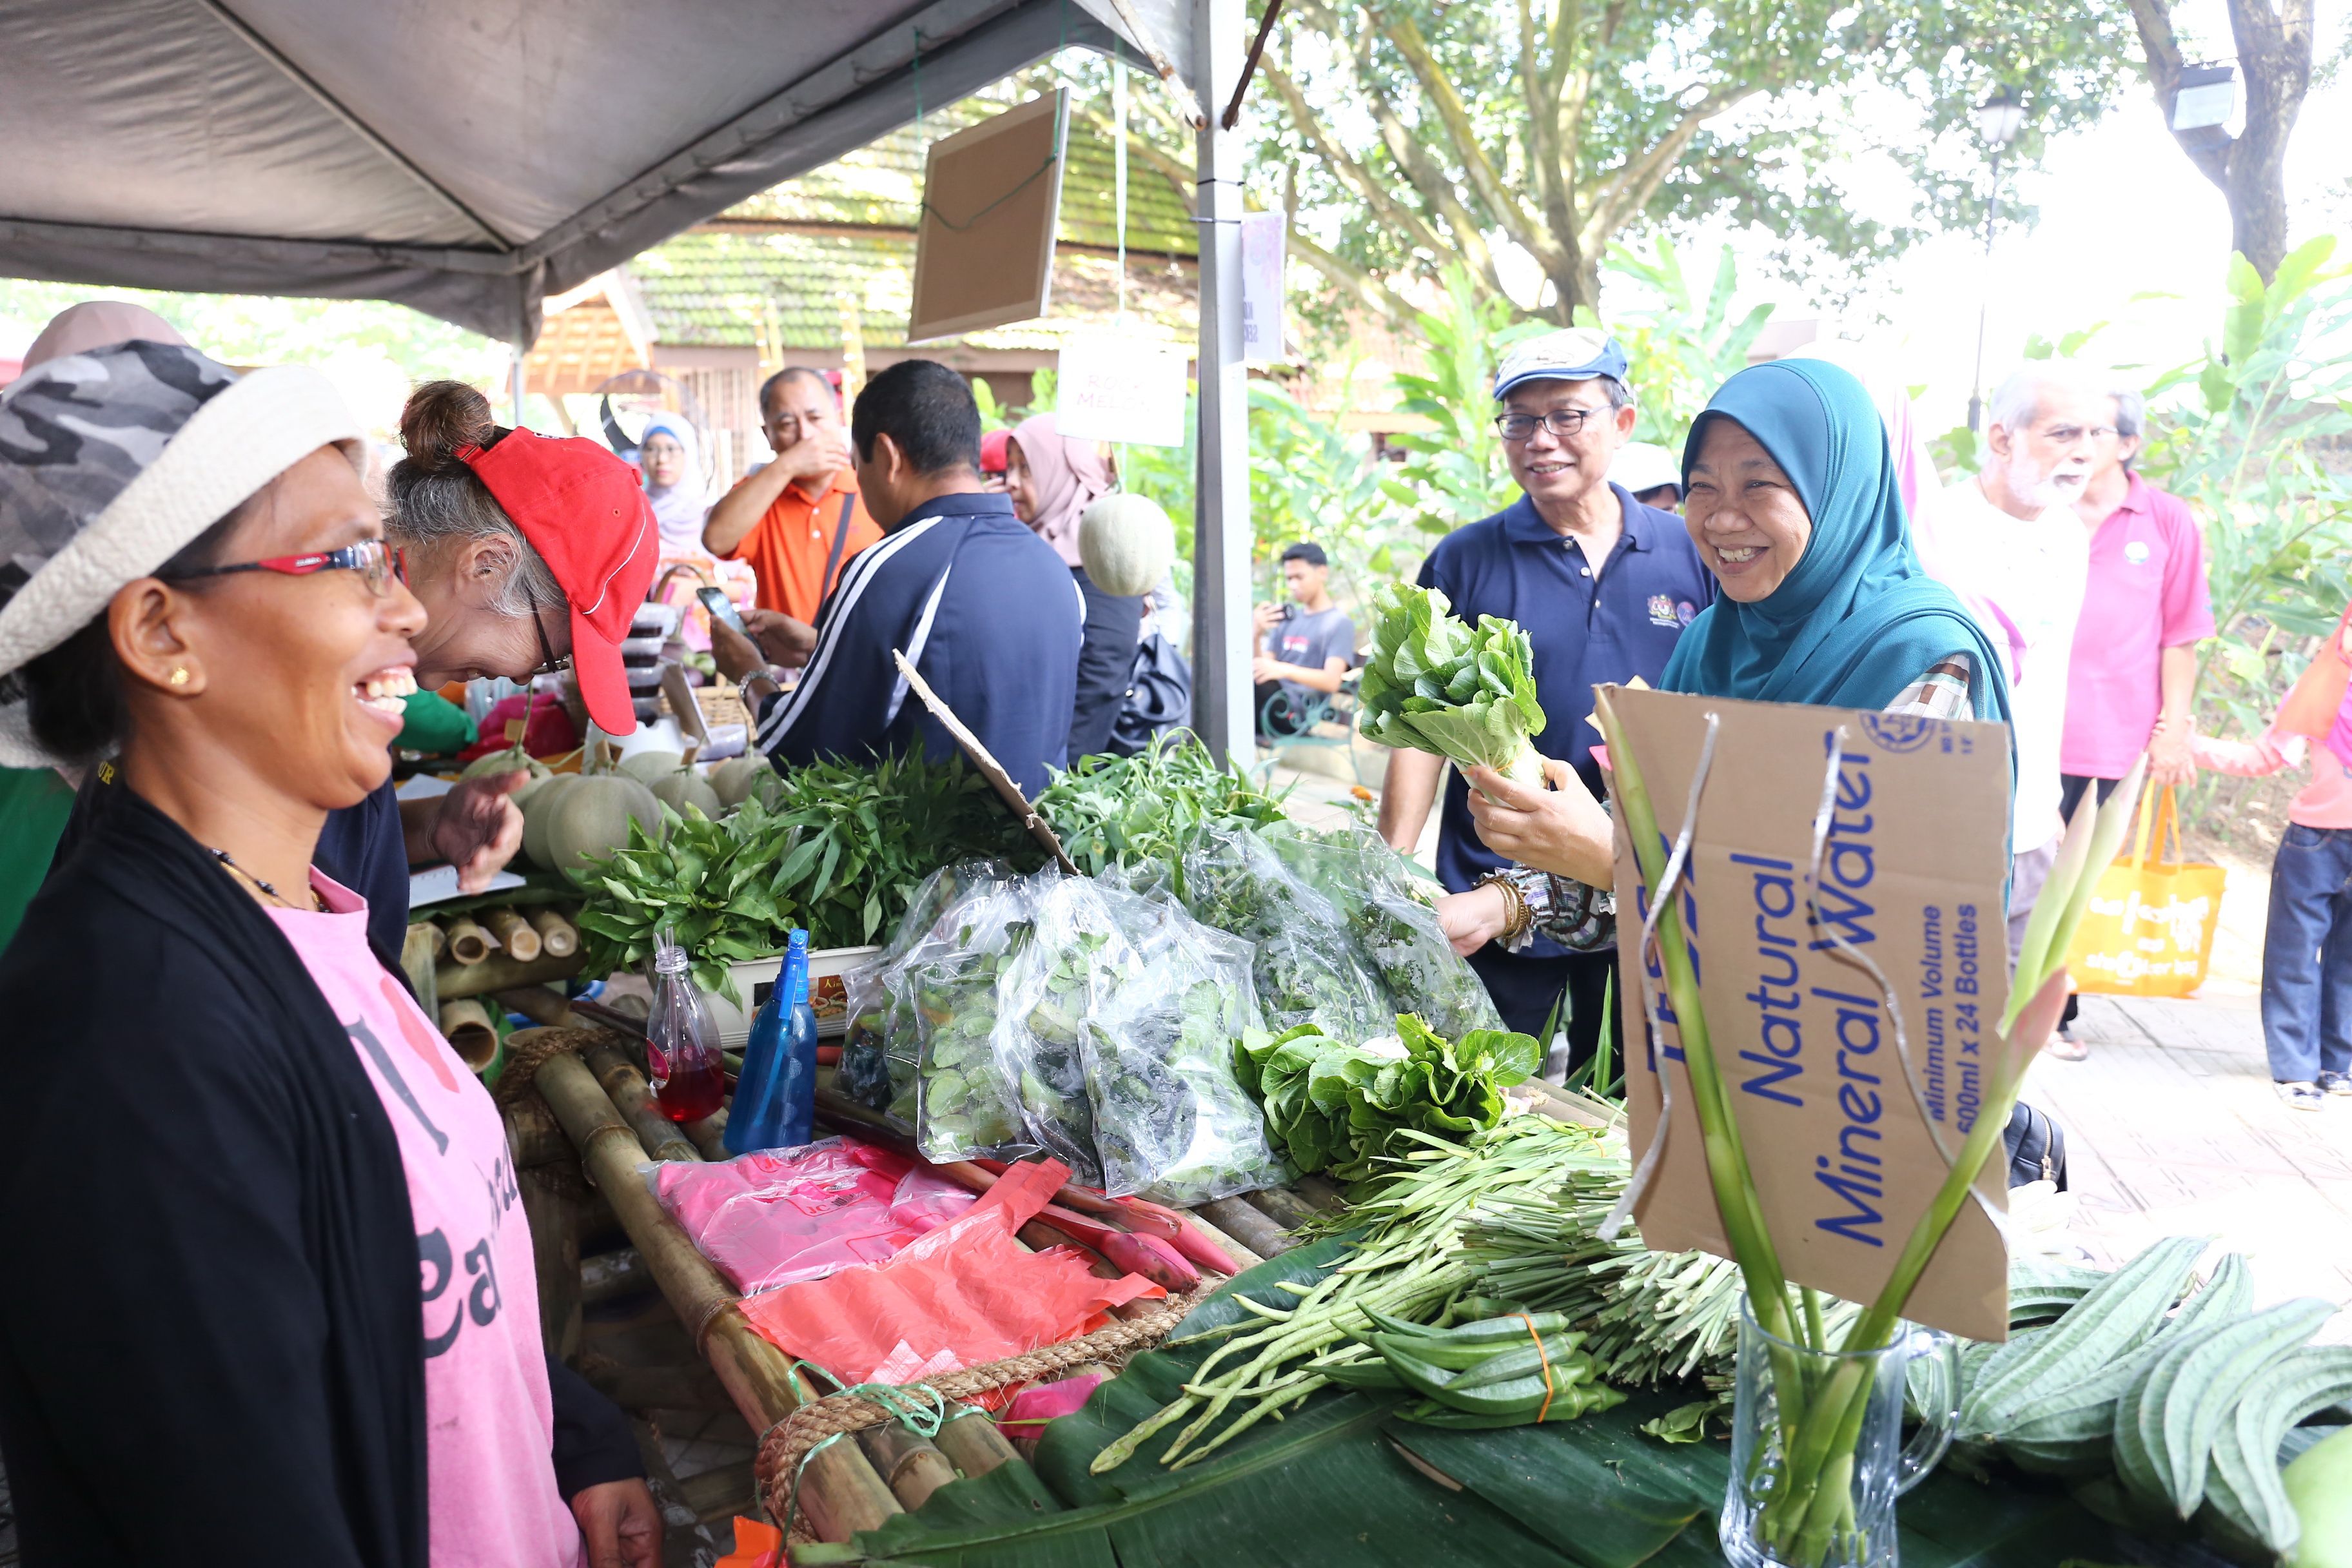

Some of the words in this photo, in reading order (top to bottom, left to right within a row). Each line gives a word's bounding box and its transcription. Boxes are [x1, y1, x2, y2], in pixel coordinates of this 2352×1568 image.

[1803, 730, 1876, 952] Water
[1729, 852, 1804, 1108] Natural
[1919, 905, 1943, 999] Volume
[1952, 903, 1978, 996] Bottles
[1922, 1007, 1945, 1122] Minimum
[1954, 1003, 1979, 1034] 24
[1961, 1039, 1980, 1057] x
[1810, 986, 1884, 1248] Mineral
[1955, 1061, 1981, 1135] 600ml
